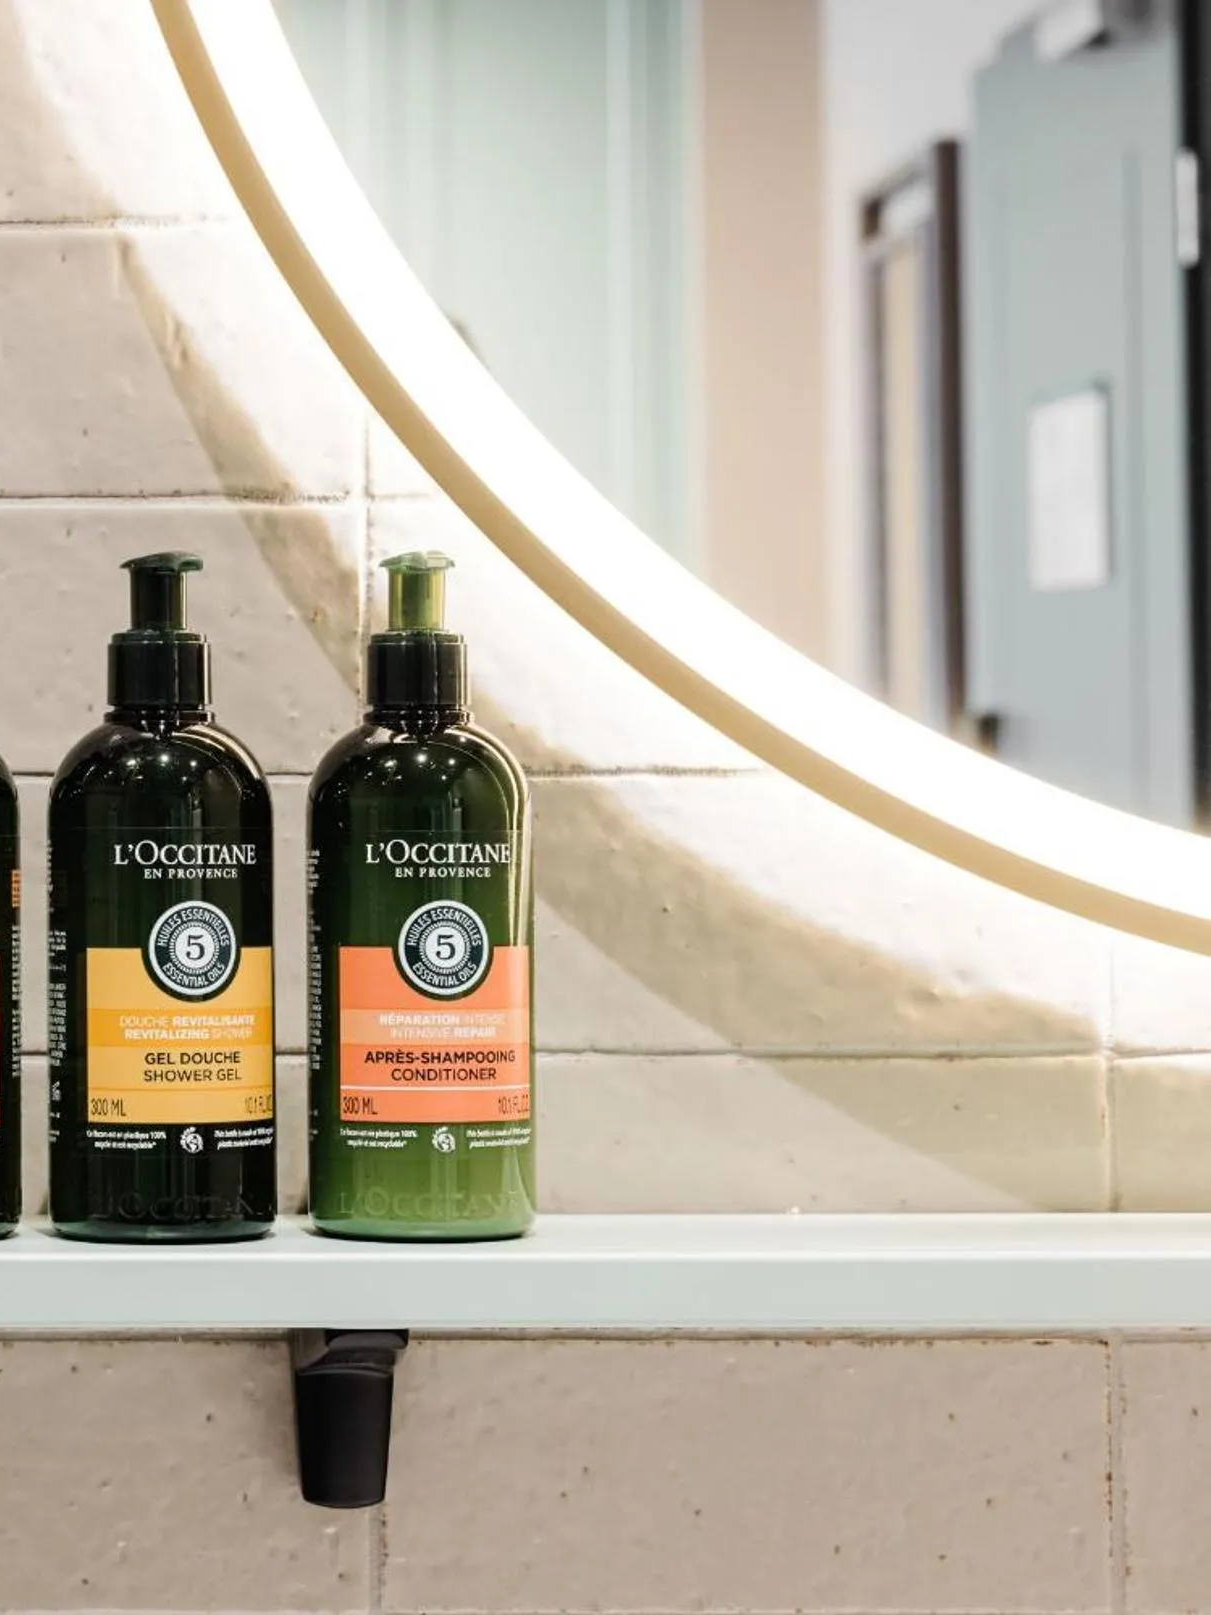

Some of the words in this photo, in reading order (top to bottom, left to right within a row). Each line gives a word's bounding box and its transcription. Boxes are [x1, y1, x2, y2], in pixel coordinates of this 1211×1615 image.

[113, 839, 257, 865] L'OCCITANE
[365, 838, 511, 864] L'OCCITANE
[144, 868, 163, 879] EN
[168, 868, 238, 879] PROVENCE
[394, 866, 414, 878] EN
[419, 866, 492, 878] PROVENCE
[156, 913, 182, 947] HUILES
[181, 908, 230, 947] ESSENTIELLES
[406, 913, 431, 946] HUILES
[430, 908, 482, 947] ESSENTIELLES
[185, 934, 206, 960] 5
[435, 934, 456, 960] 5
[162, 962, 208, 987] ESSENTIAL
[207, 962, 225, 981] OILS
[412, 962, 460, 987] ESSENTIAL
[458, 962, 477, 981] OILS
[120, 1016, 170, 1027] DOUCHE
[172, 1014, 255, 1026] REVITALISANTE
[379, 1012, 461, 1025] RÉPARATION
[124, 1028, 210, 1040] REVITALIZING
[390, 1027, 452, 1039] INTENSIVE
[453, 1027, 497, 1038] REPAIR
[144, 1052, 176, 1065] GEL
[179, 1051, 241, 1065] DOUCHE
[364, 1049, 516, 1064] APRÈS-SHAMPOOING
[144, 1069, 213, 1082] SHOWER
[216, 1068, 242, 1081] GEL
[391, 1067, 497, 1081] CONDITIONER
[90, 1098, 108, 1116] 300
[111, 1099, 127, 1116] ML
[343, 1097, 359, 1115] 300
[362, 1097, 378, 1115] ML
